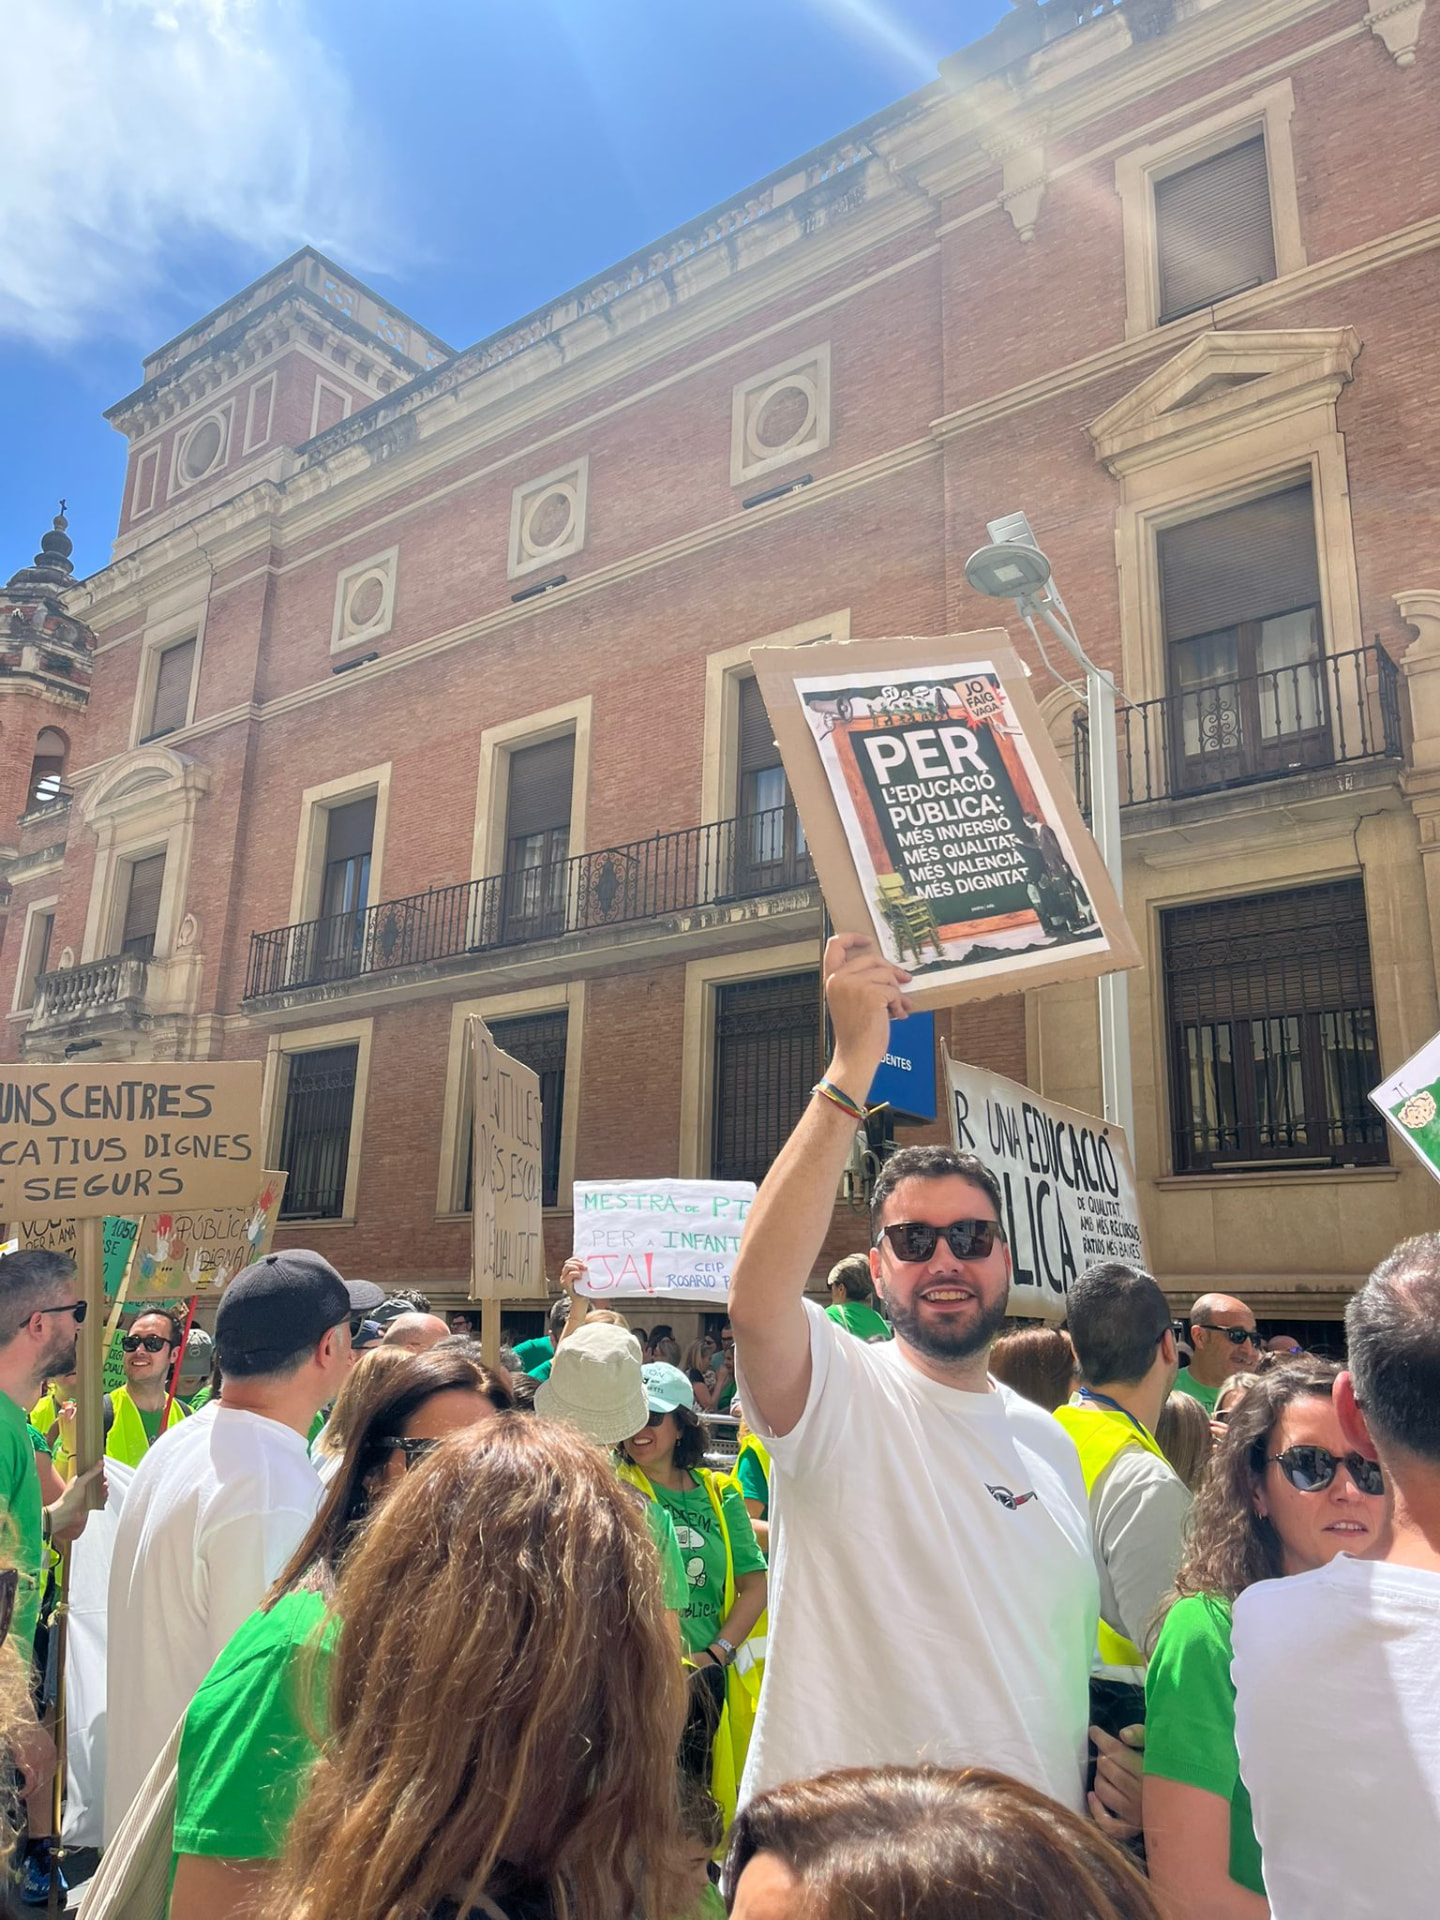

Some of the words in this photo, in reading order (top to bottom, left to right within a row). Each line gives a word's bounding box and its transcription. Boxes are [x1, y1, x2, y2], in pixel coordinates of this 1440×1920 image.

[965, 680, 984, 697] JO
[966, 691, 995, 709] FAIG
[971, 702, 1000, 717] VAGA
[863, 726, 989, 785] PER
[888, 793, 1005, 829] PÚBLICA:
[896, 826, 935, 847] MÉS
[936, 813, 1012, 841] INVERSIÓ
[902, 846, 940, 865] MÉS
[908, 863, 946, 883] MÉS
[946, 848, 1026, 876] VALENCIÀ
[915, 880, 954, 900] MÉS
[955, 867, 1029, 894] DIGNITAT
[60, 1081, 215, 1122] CENTRES
[144, 1133, 252, 1161] DIGNES
[987, 1099, 1024, 1161] UNA
[1022, 1102, 1119, 1198] EDUCACIÓ
[24, 1167, 184, 1201] SEGURS
[584, 1193, 678, 1213] MESTRA
[1077, 1196, 1086, 1211] DE
[111, 1219, 138, 1241] 1050
[990, 1168, 1077, 1294] LICA
[1080, 1215, 1095, 1232] AMB
[592, 1230, 636, 1248] PER
[587, 1252, 655, 1294] JA!
[695, 1262, 724, 1273] CEIP
[666, 1273, 717, 1288] ROSARIO
